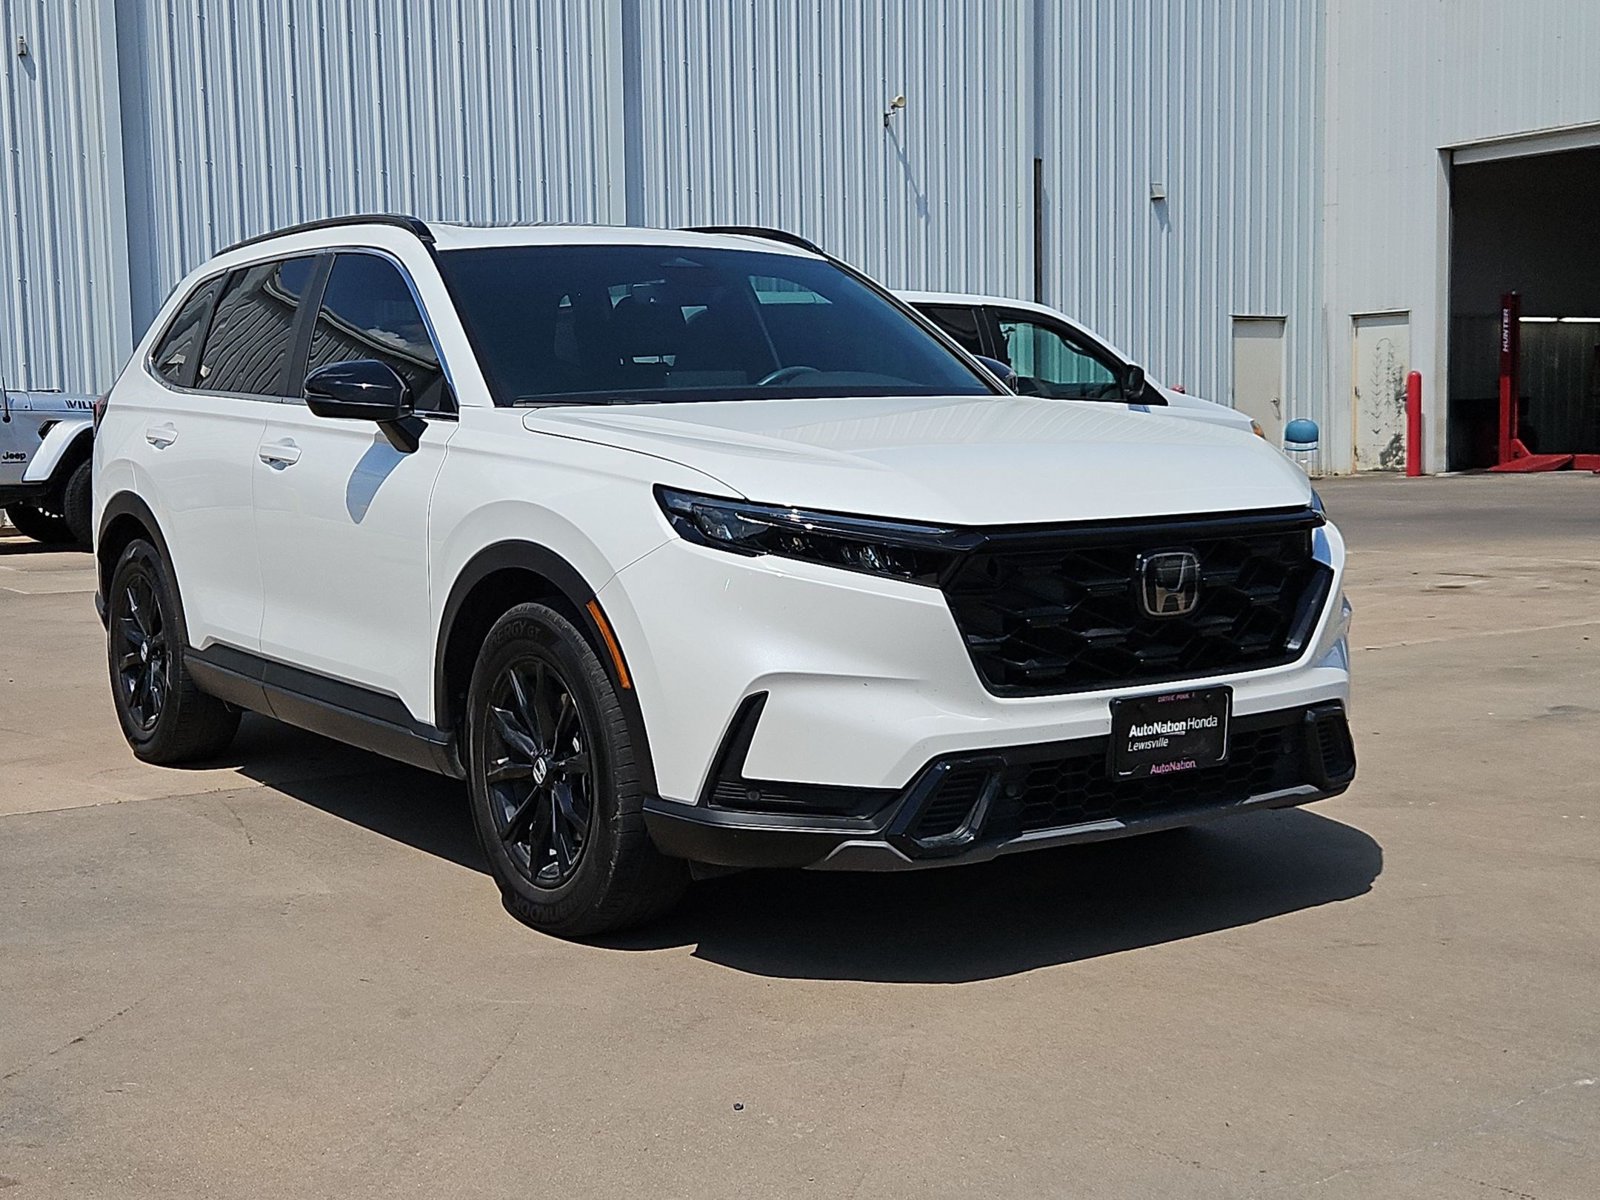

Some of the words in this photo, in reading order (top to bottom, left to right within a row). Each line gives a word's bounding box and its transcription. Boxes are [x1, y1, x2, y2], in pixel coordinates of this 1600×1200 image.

[65, 400, 95, 409] WILL
[2, 451, 27, 461] Jeep
[1129, 721, 1186, 737] AutoNation
[1187, 715, 1218, 730] Honda
[1128, 738, 1169, 751] Lewisville
[1150, 760, 1196, 774] AutoNation
